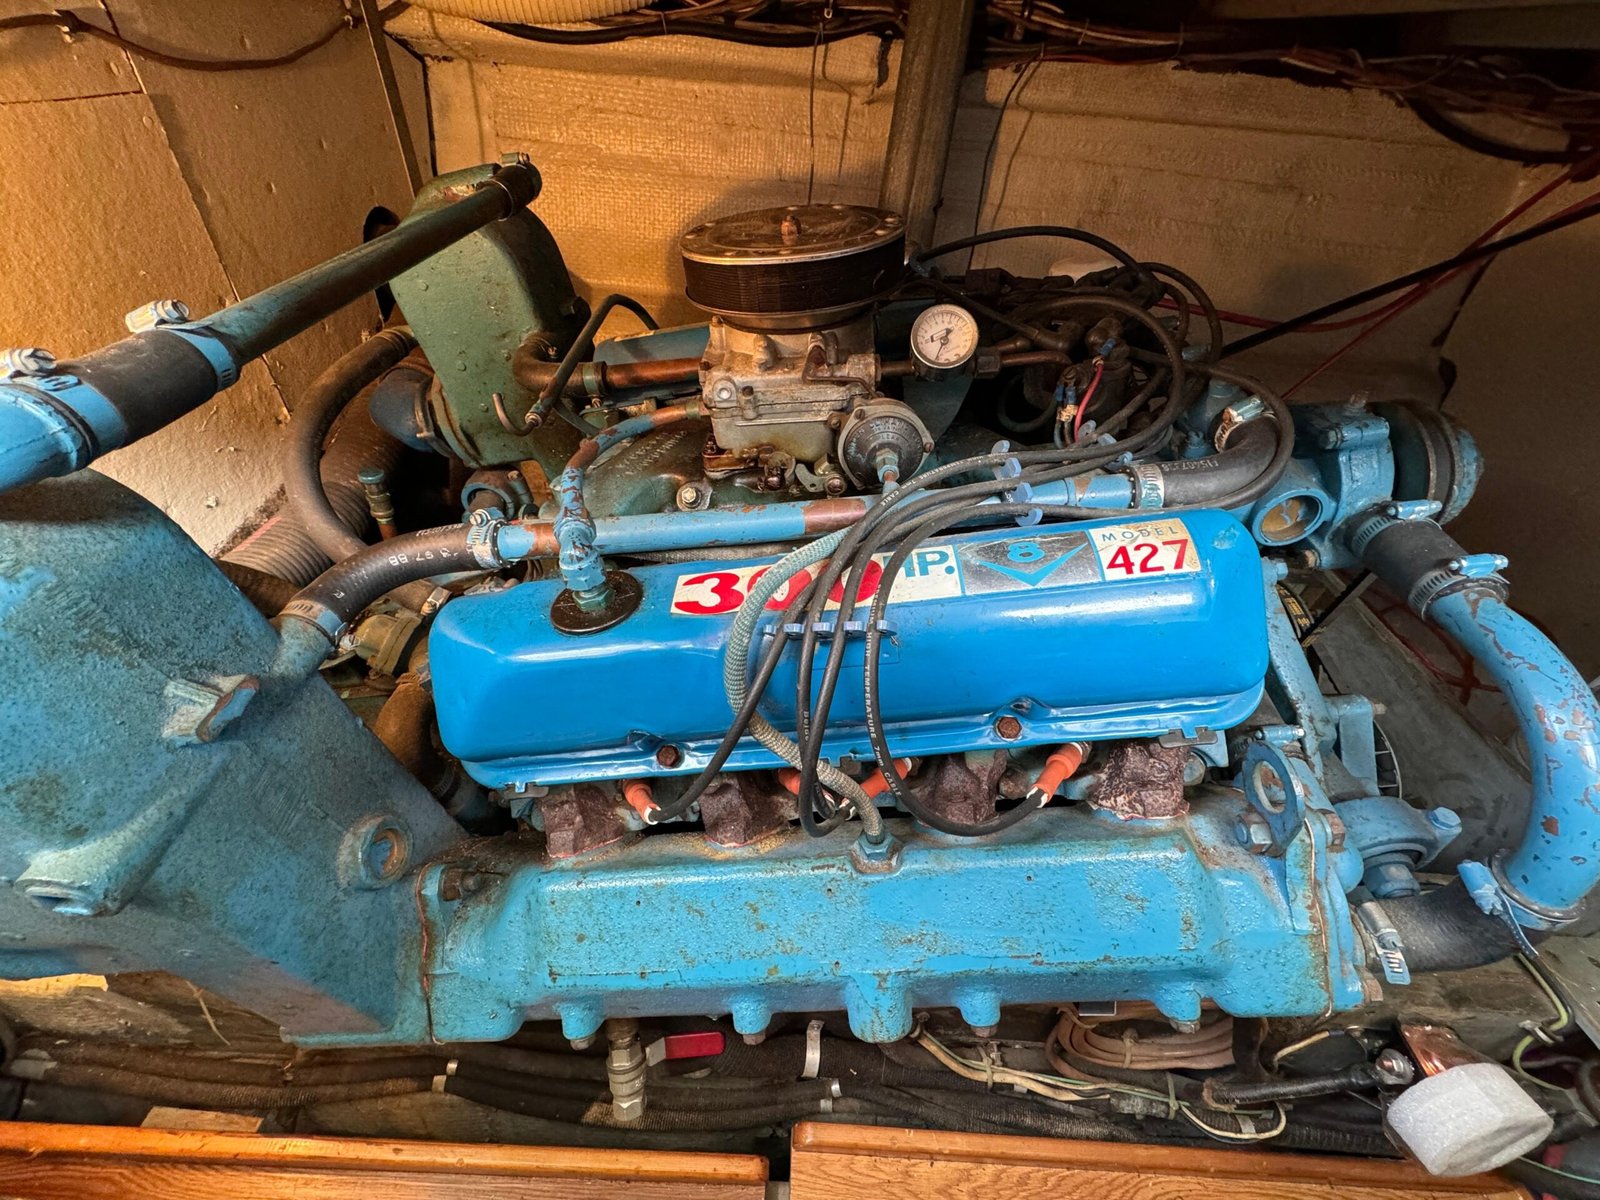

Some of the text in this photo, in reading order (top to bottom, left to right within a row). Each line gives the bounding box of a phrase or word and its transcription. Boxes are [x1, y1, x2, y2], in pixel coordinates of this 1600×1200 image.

[1102, 526, 1178, 542] MODEL
[1007, 541, 1045, 563] 8
[1106, 538, 1189, 575] 427
[865, 632, 873, 657] HIGH
[864, 664, 877, 739] TEMPERATURE
[873, 745, 884, 767] 7mm
[884, 772, 902, 797] CABLE
